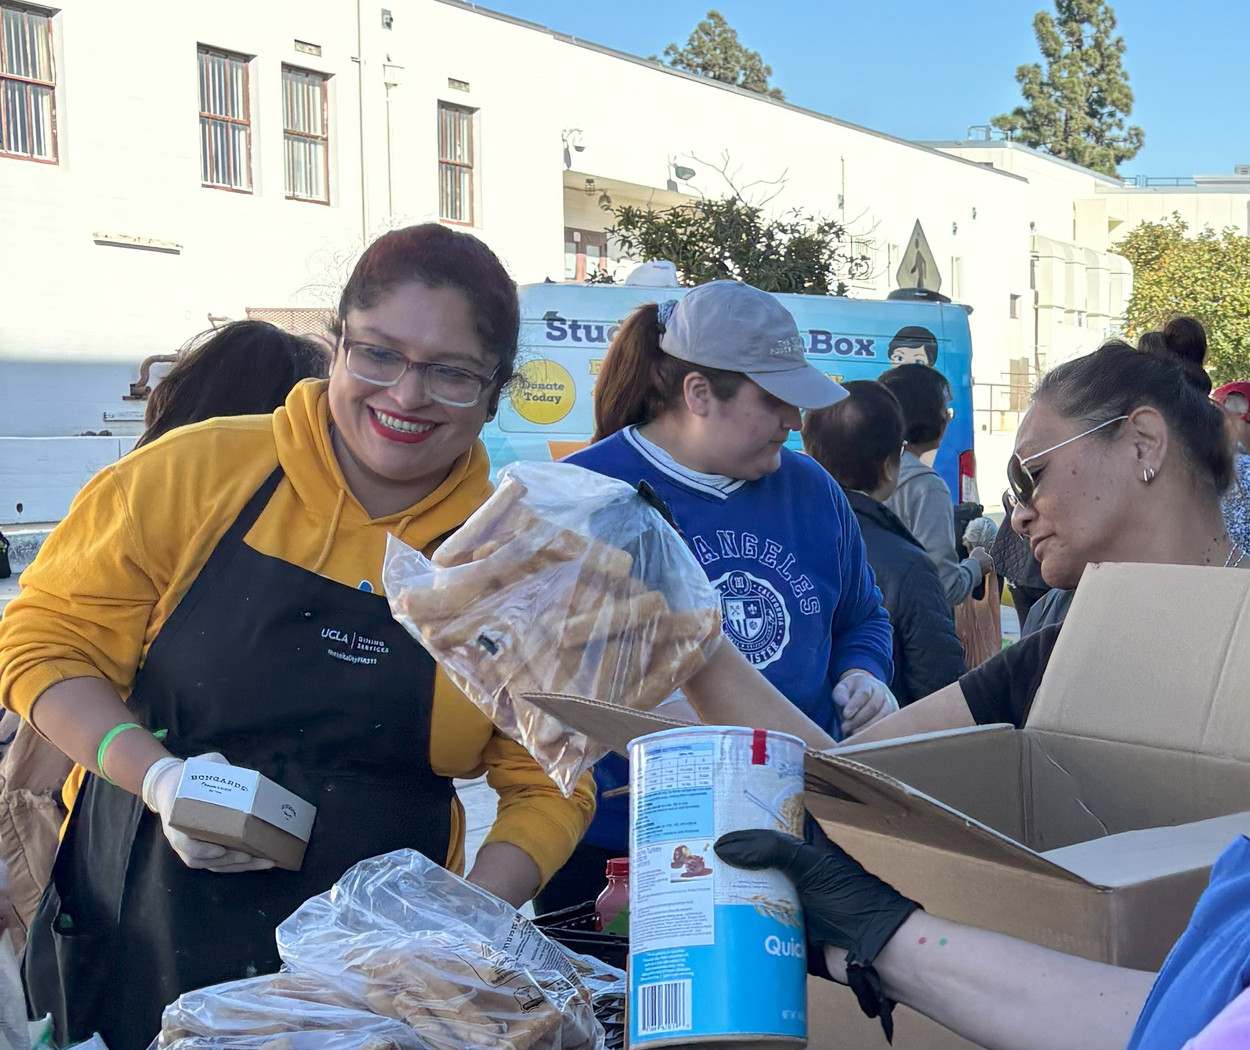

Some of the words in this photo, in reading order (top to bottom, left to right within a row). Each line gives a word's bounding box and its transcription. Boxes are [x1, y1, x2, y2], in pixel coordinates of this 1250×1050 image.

[521, 381, 564, 392] Donate
[524, 392, 562, 404] Today
[692, 529, 821, 615] ANGELES
[756, 585, 784, 626] CALIFORNIA
[321, 628, 348, 645] UCLA
[358, 636, 384, 647] DINING
